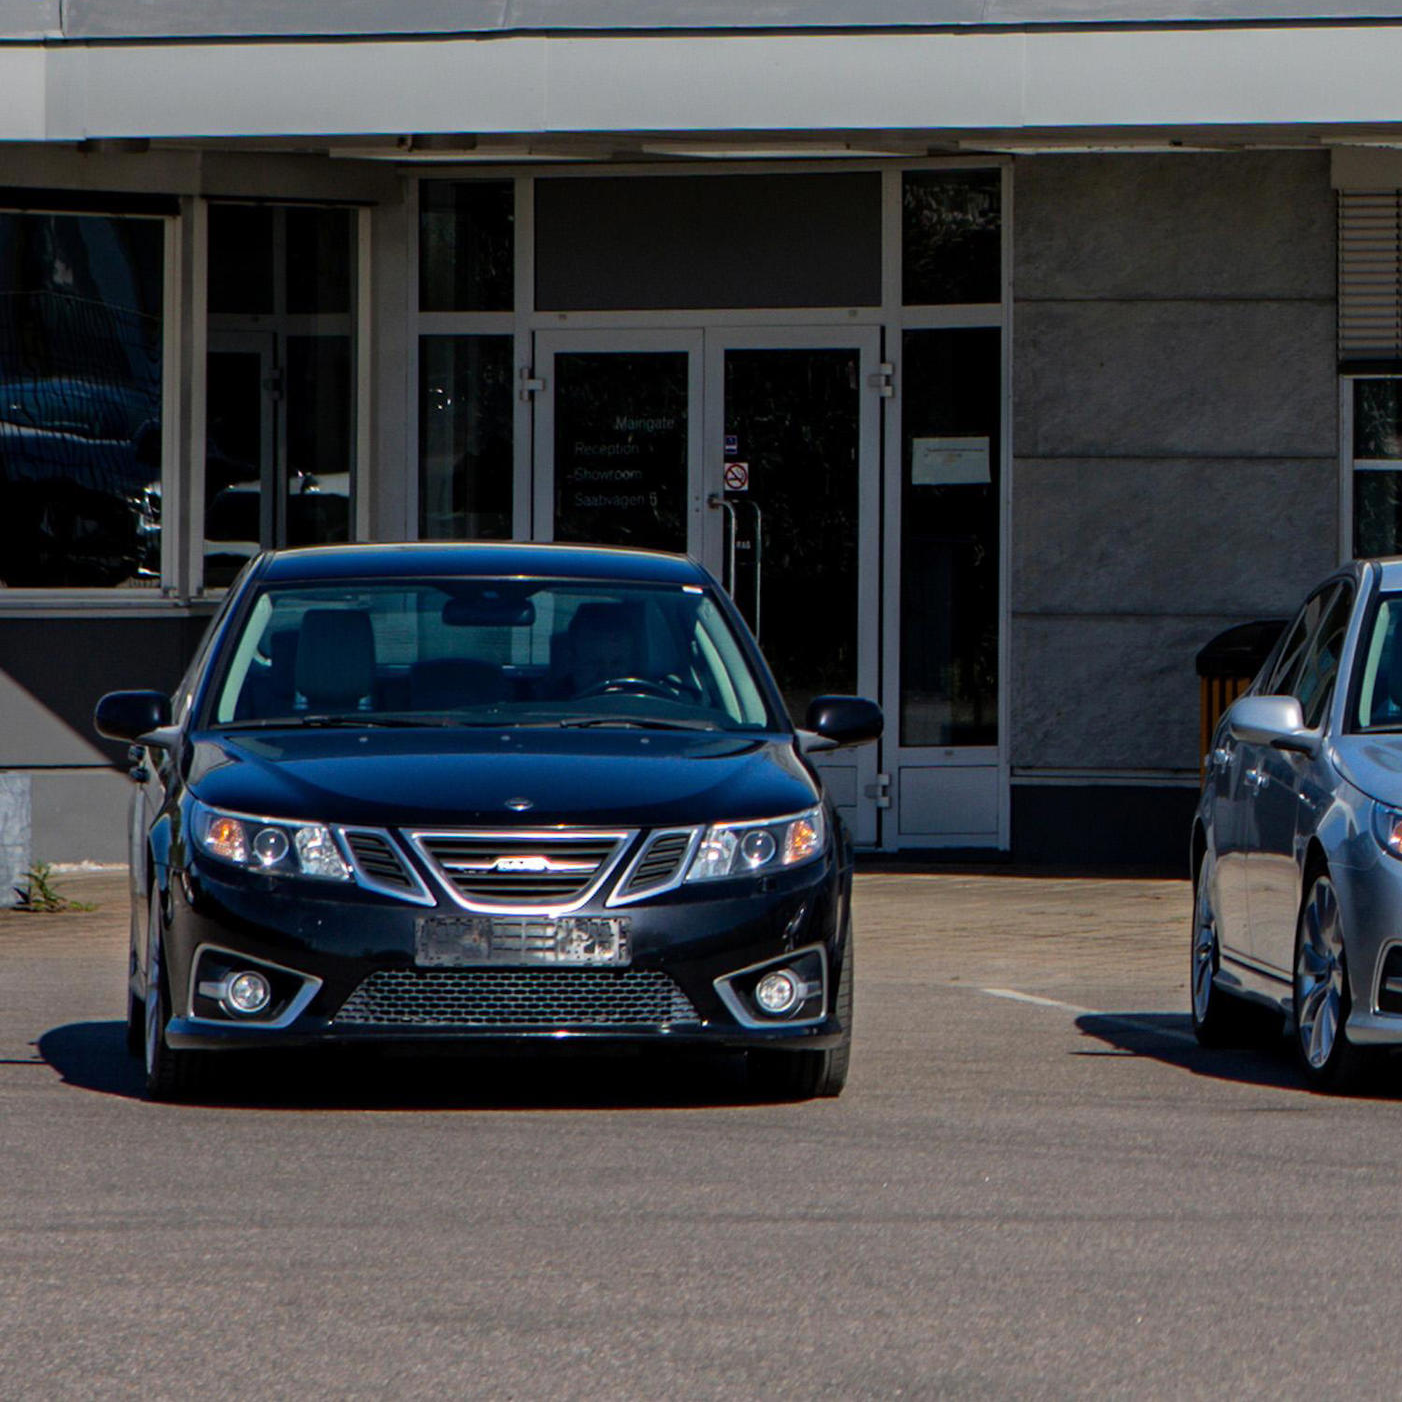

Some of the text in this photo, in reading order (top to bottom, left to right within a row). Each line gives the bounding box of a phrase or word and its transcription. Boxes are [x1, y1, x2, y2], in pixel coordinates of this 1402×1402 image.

[615, 415, 675, 432] Maingate
[575, 441, 640, 457] Reception
[574, 467, 642, 480] Showroom
